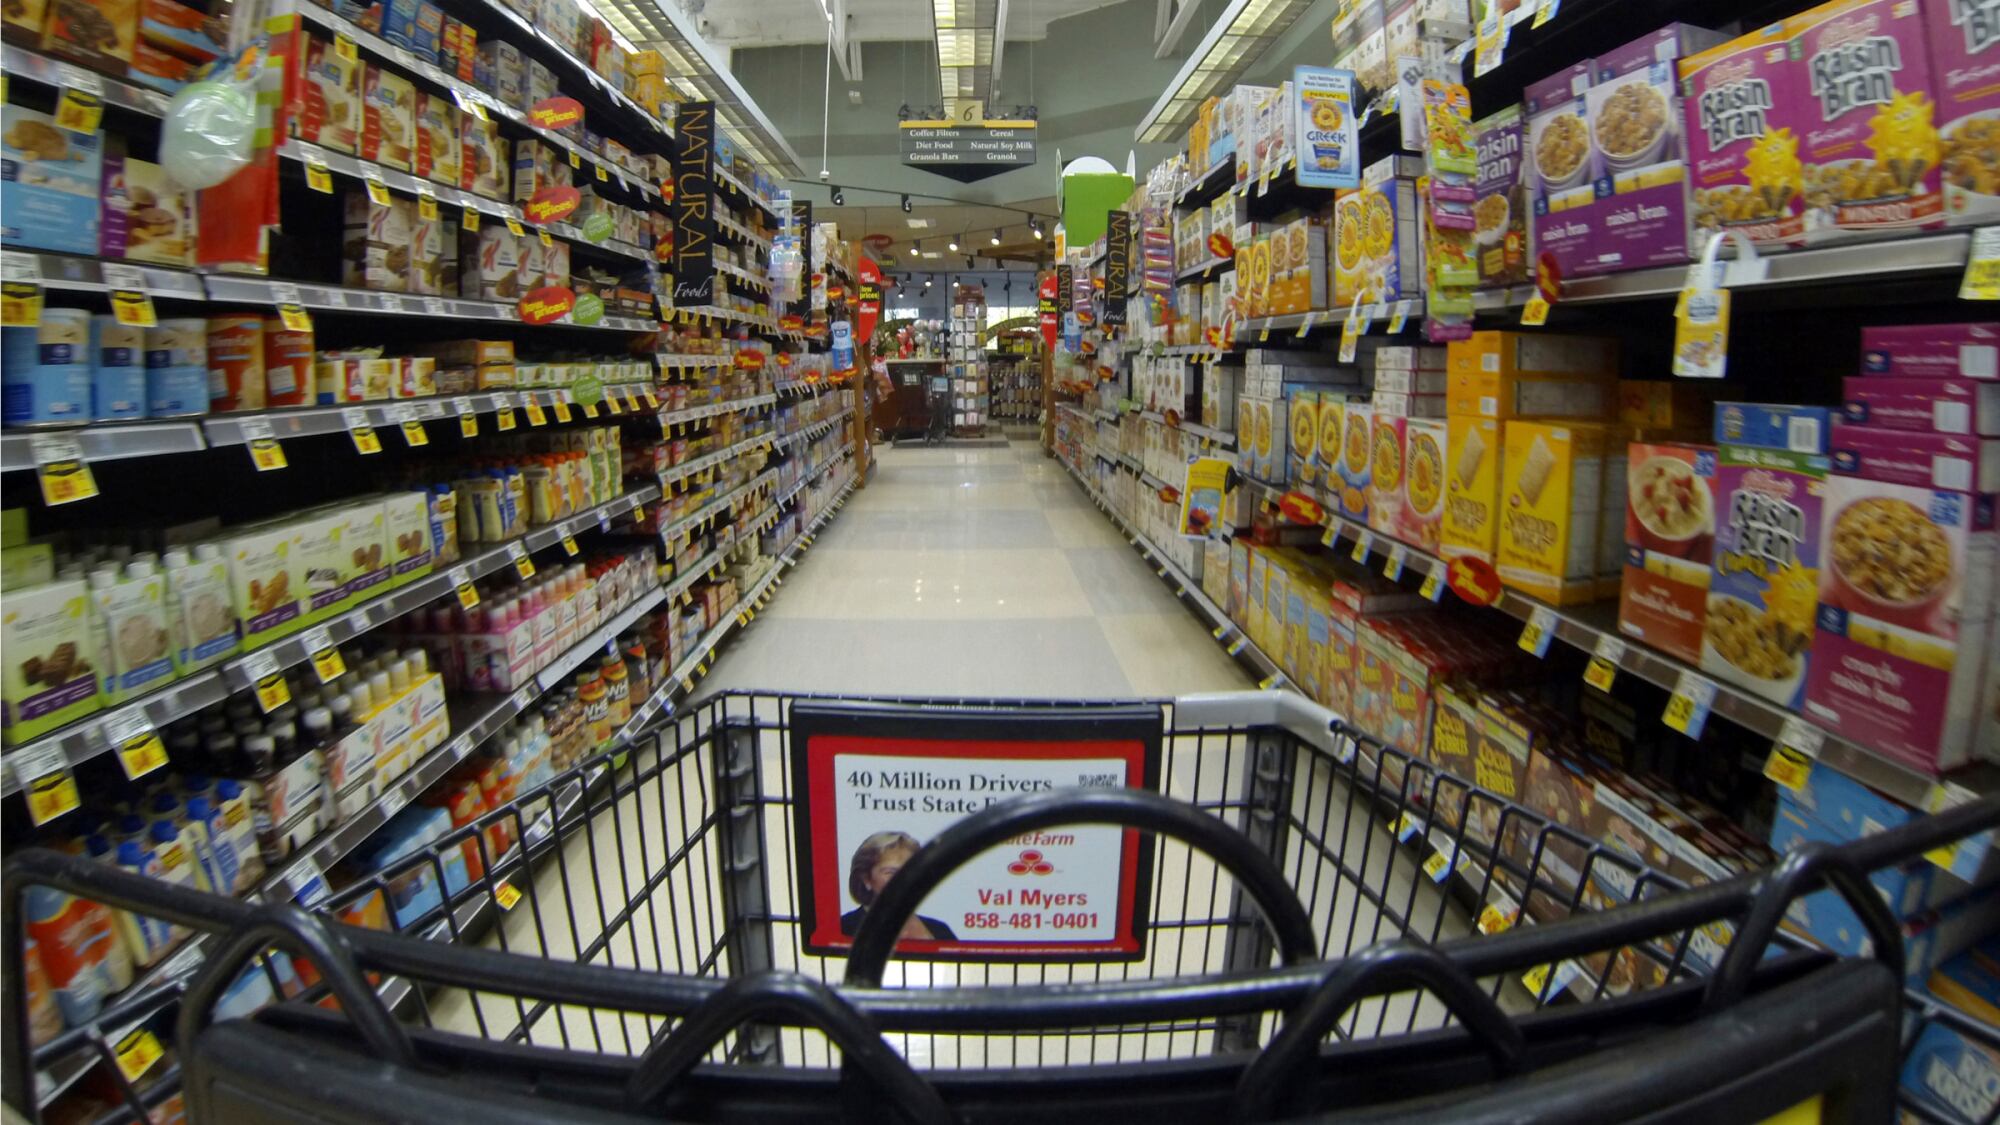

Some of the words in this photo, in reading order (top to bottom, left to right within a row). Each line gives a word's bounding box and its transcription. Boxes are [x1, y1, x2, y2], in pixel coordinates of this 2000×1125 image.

[1808, 35, 1903, 96] Raisin
[1698, 78, 1773, 129] Raisin
[1821, 70, 1894, 122] Bran
[962, 106, 975, 122] 6
[909, 129, 935, 137] Coffee
[936, 129, 960, 137] Filters
[990, 129, 1014, 137] Cereal
[1306, 130, 1347, 143] GREEK
[1709, 108, 1765, 152] Bran
[916, 141, 933, 149] Diet
[934, 141, 953, 149] Food
[970, 142, 999, 150] Natural
[1001, 142, 1013, 151] Soy
[1015, 141, 1033, 149] Milk
[909, 152, 941, 160] Granola
[942, 152, 959, 160] Bars
[986, 152, 1017, 160] Granola
[679, 109, 708, 273] NATURAL
[1107, 213, 1128, 305] NATURAL
[674, 275, 713, 299] Foods
[847, 771, 874, 788] 40
[879, 771, 962, 791] Million
[969, 773, 1053, 793] Drivers
[854, 792, 917, 812] Trust
[922, 794, 977, 814] State
[978, 889, 1013, 906] Val
[1020, 889, 1088, 910] Myers
[963, 912, 1098, 930] 858-481-0401
